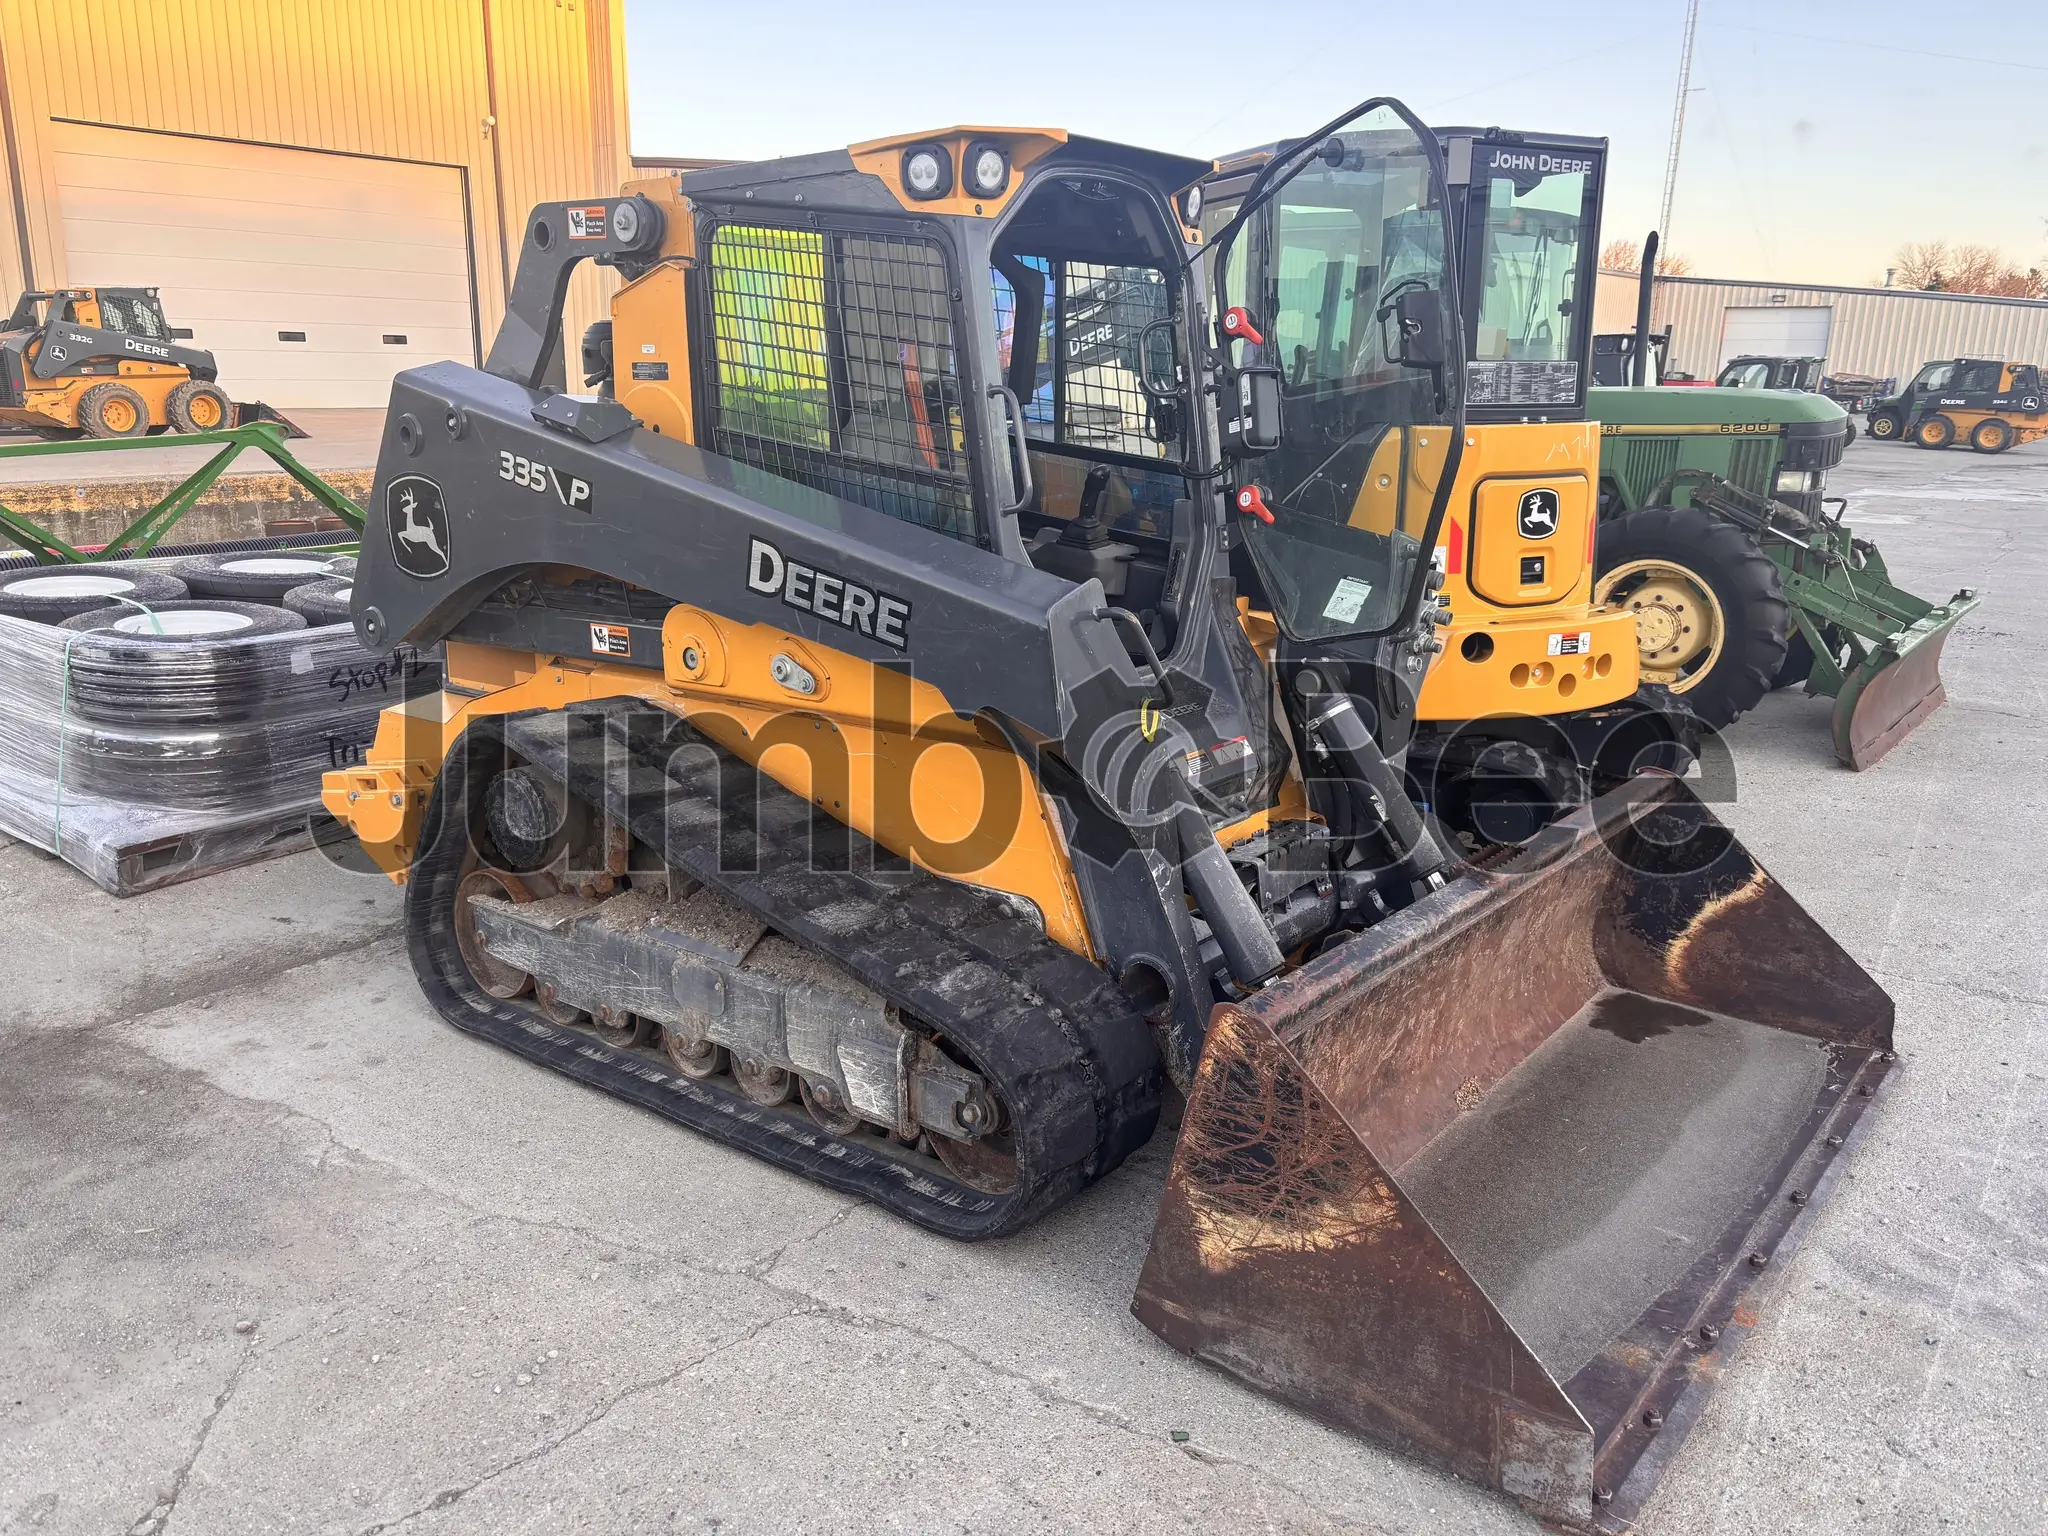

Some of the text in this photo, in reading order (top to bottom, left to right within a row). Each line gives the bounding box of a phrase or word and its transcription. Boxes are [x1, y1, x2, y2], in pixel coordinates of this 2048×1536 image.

[1489, 150, 1593, 175] JOHN DEERE
[69, 333, 93, 344] 332G
[124, 338, 170, 358] DEERE
[1069, 324, 1113, 357] DEERE
[1719, 423, 1770, 434] 6200
[748, 537, 910, 650] DEERE
[1160, 702, 1204, 720] DEERE
